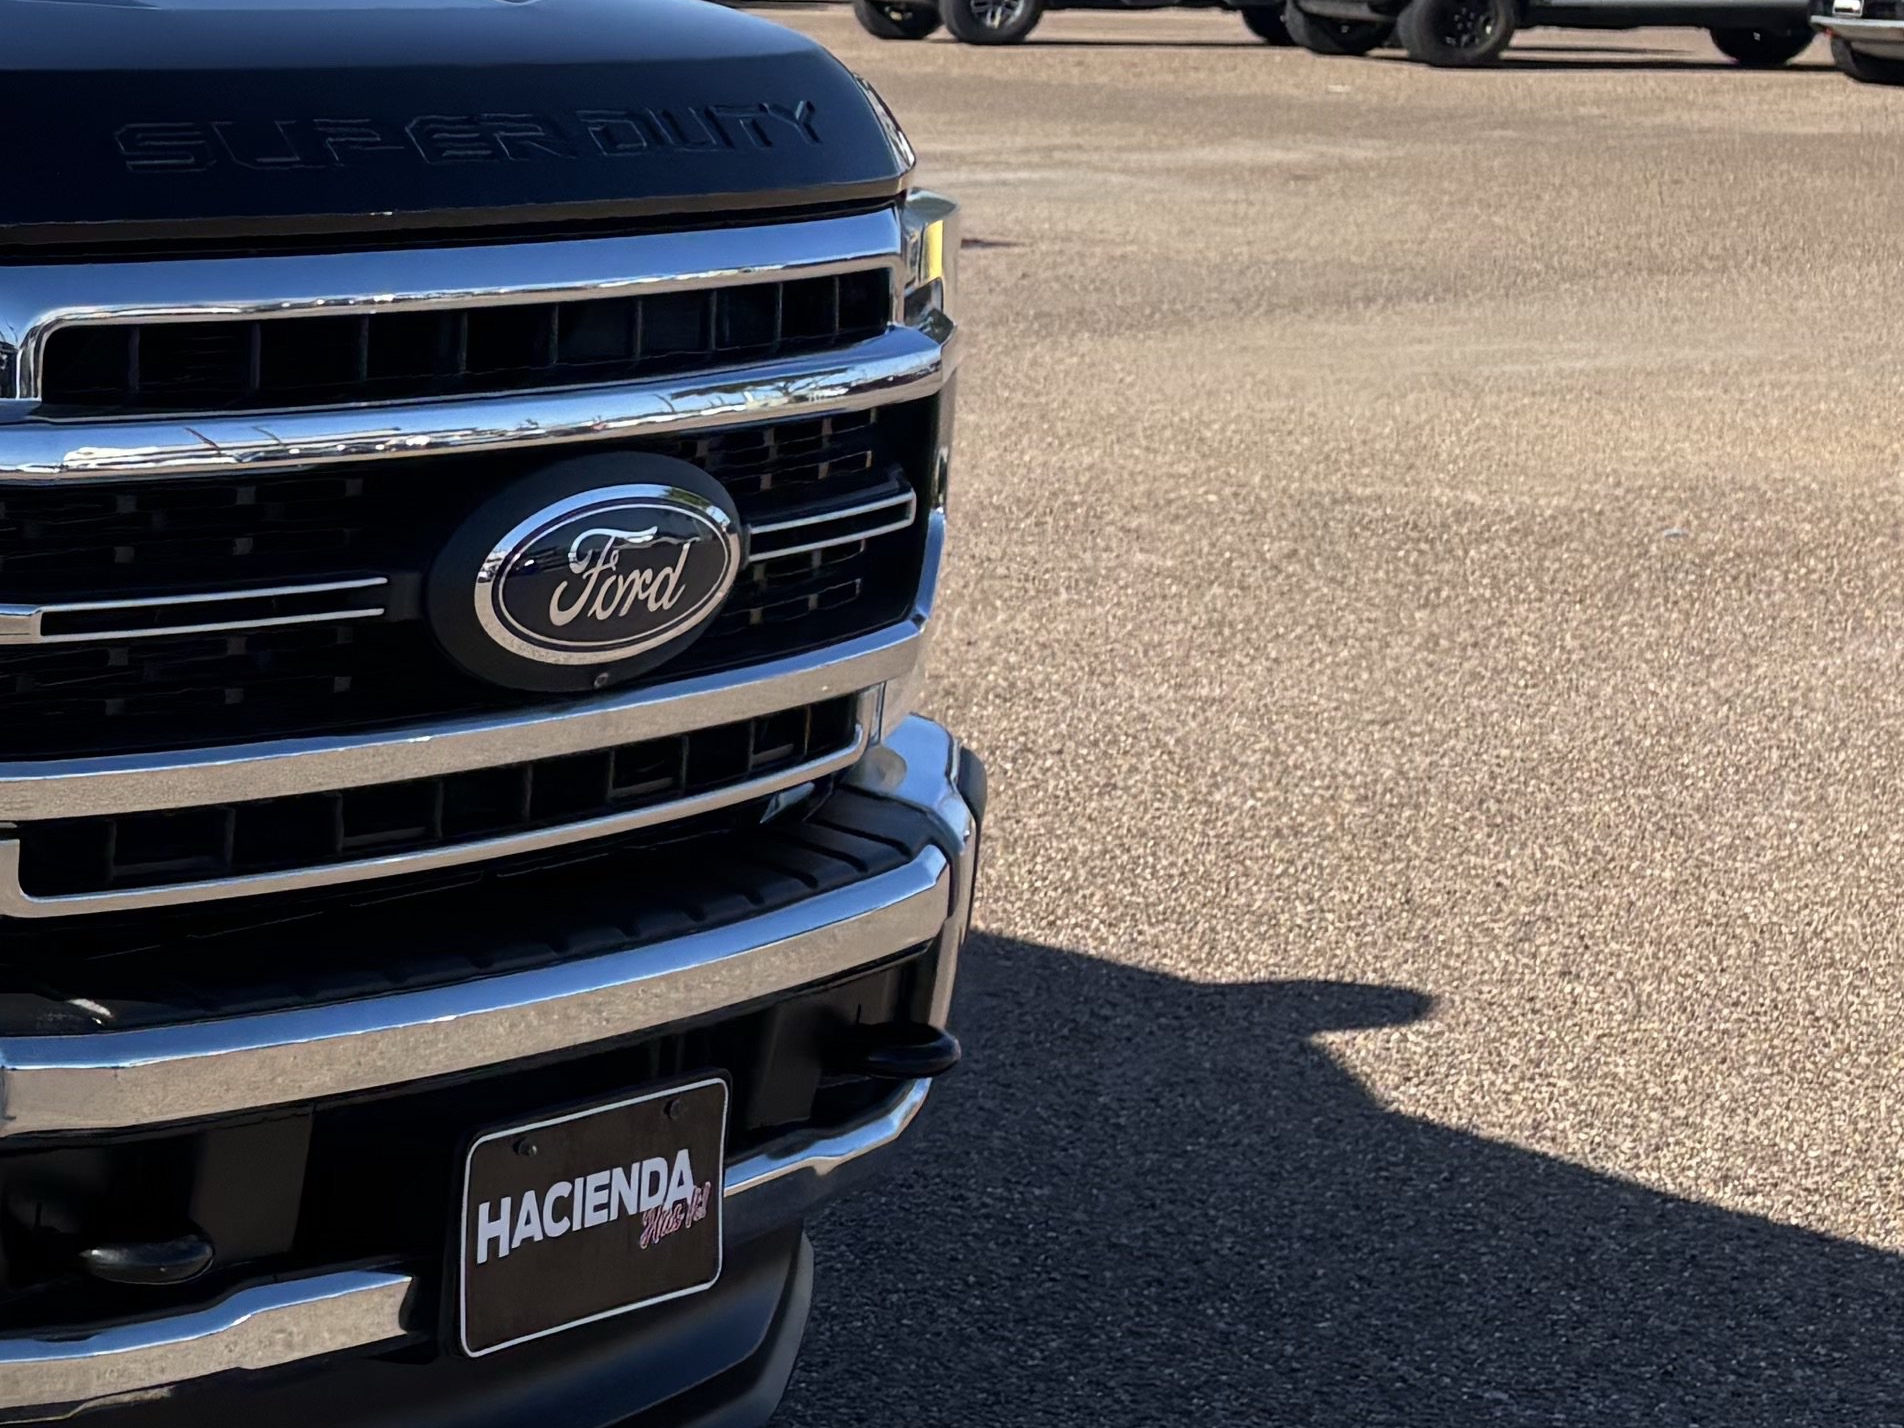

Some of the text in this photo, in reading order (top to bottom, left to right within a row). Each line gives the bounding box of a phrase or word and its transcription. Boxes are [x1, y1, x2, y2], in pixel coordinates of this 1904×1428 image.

[113, 99, 823, 171] SUPER DUTY
[549, 526, 700, 626] Ford
[476, 1149, 695, 1265] HACIENDA
